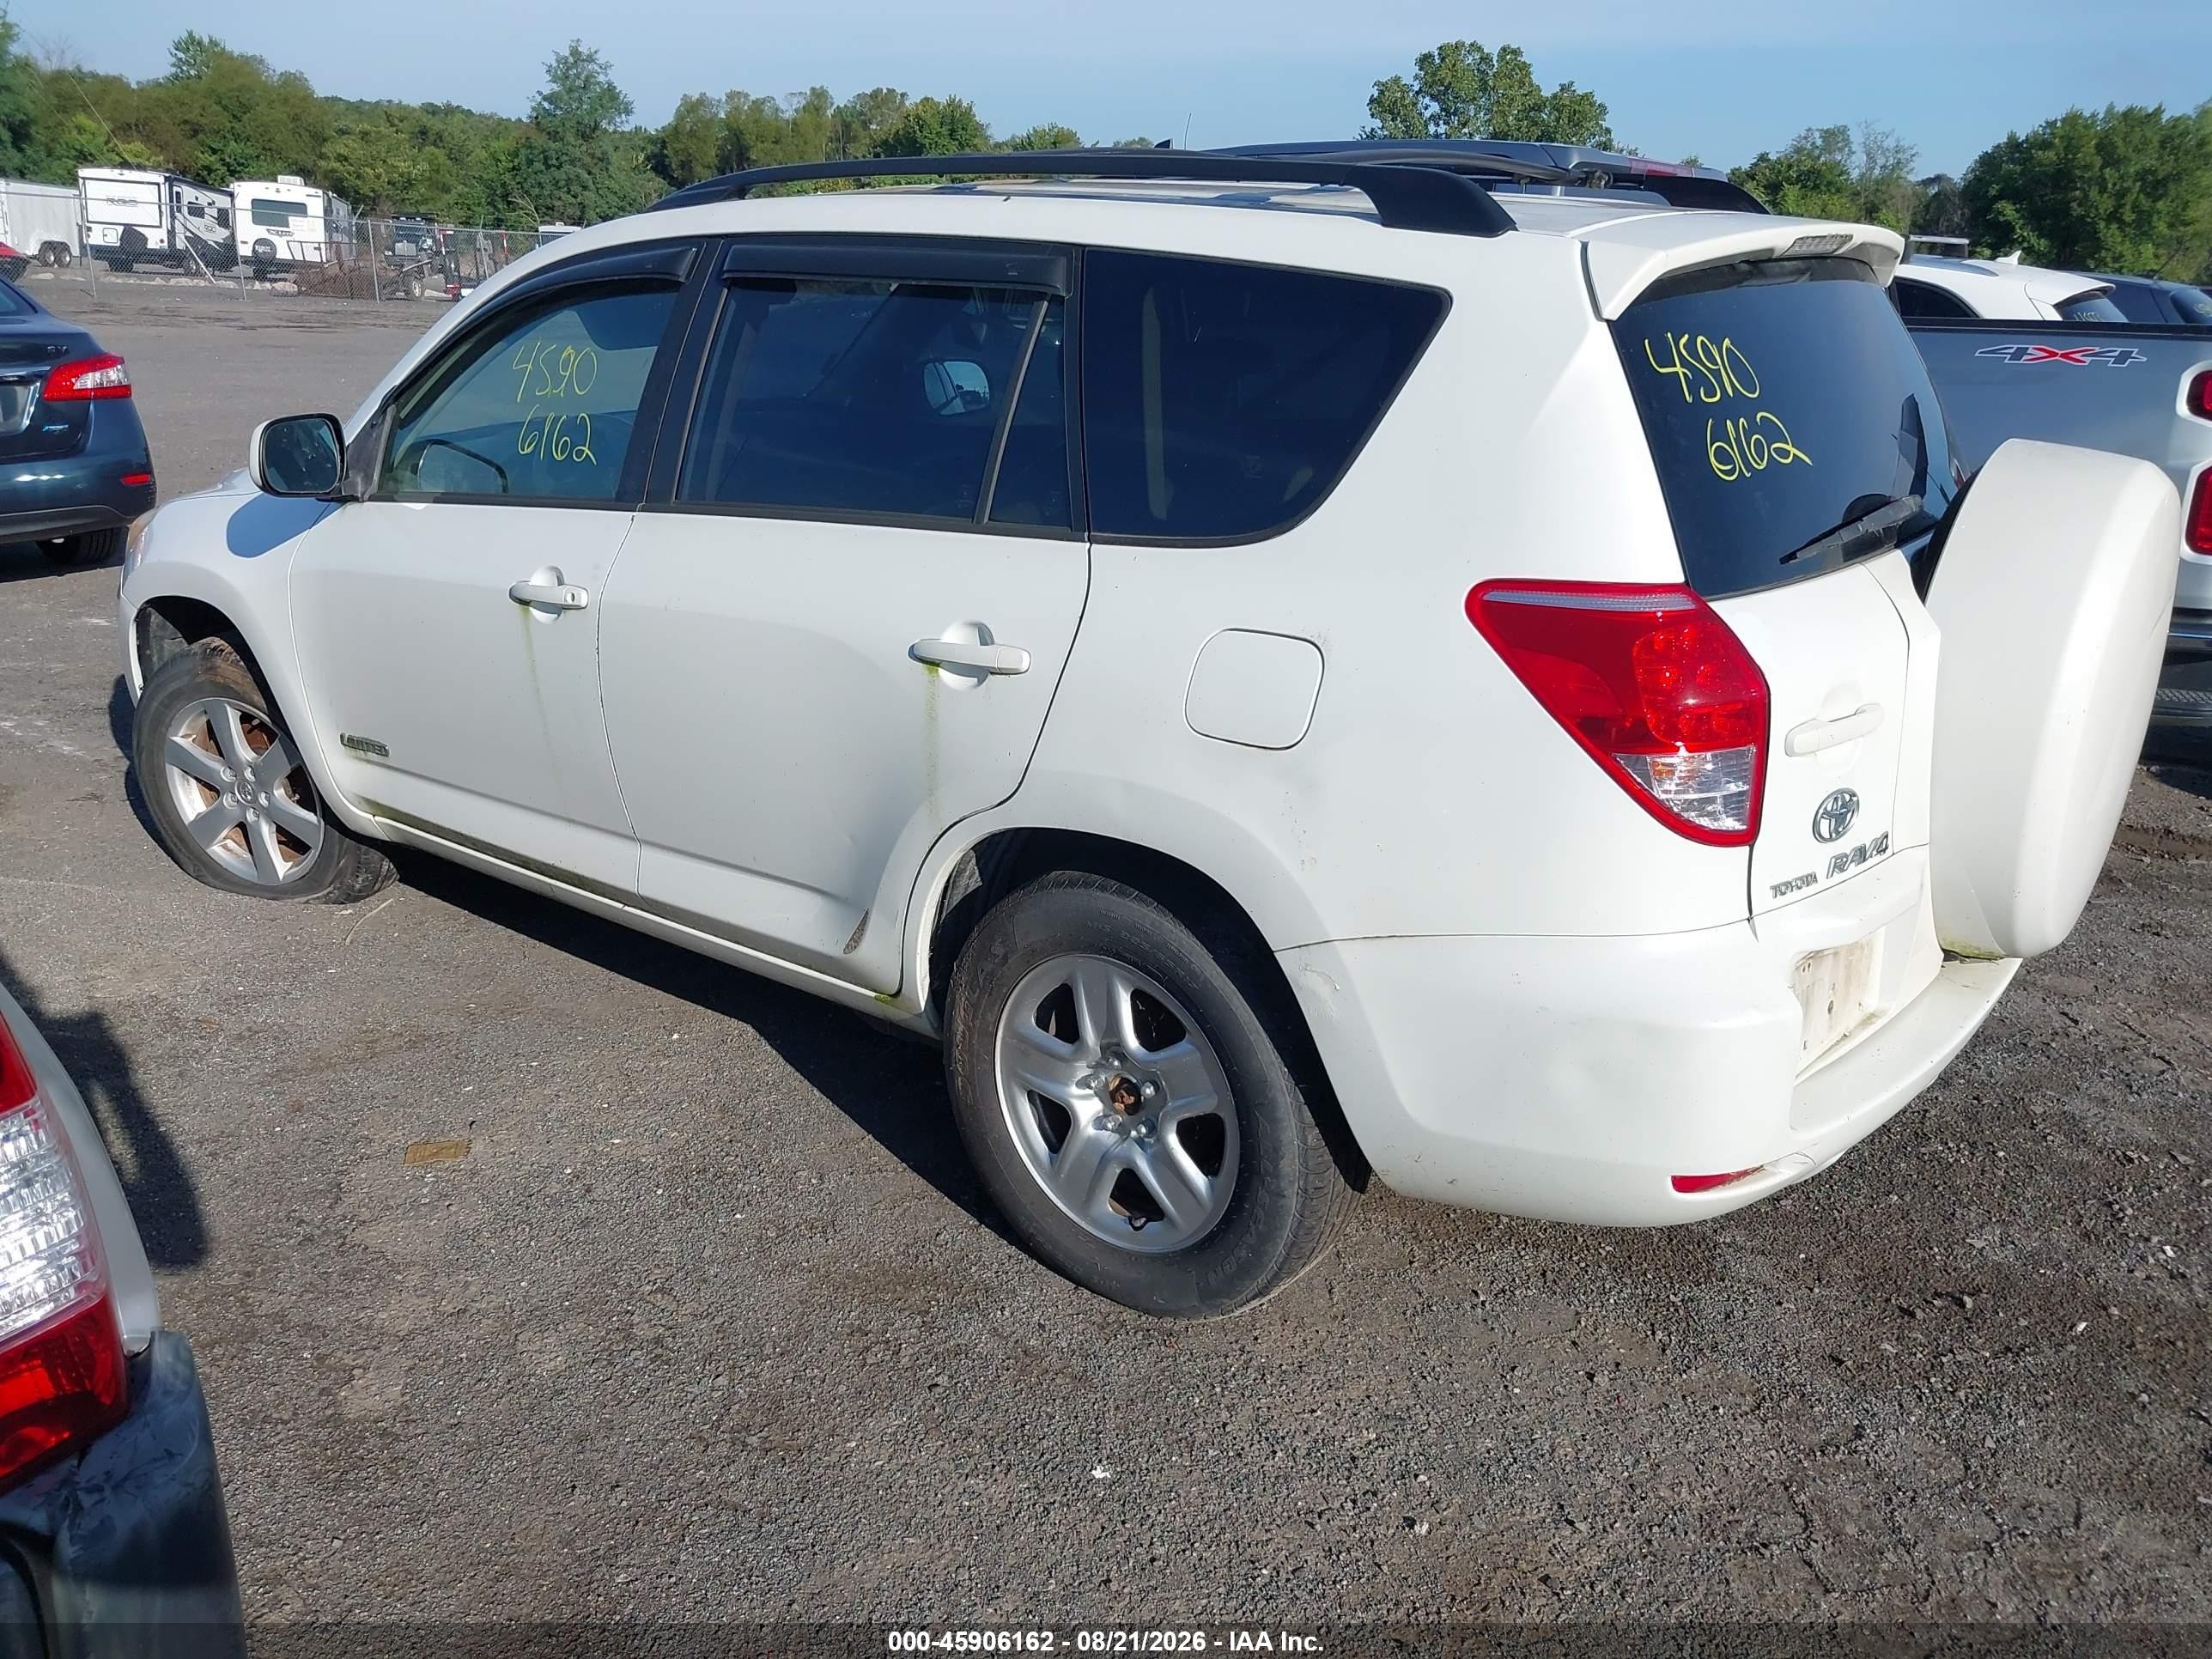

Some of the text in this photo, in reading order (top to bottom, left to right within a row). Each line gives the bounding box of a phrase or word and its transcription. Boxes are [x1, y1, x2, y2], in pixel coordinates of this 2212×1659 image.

[513, 341, 598, 403] 4590
[1644, 331, 1760, 404] 4590
[519, 404, 598, 465] 6162
[1706, 411, 1814, 481] 6162
[1769, 831, 1890, 899] TOYOTA RAV4
